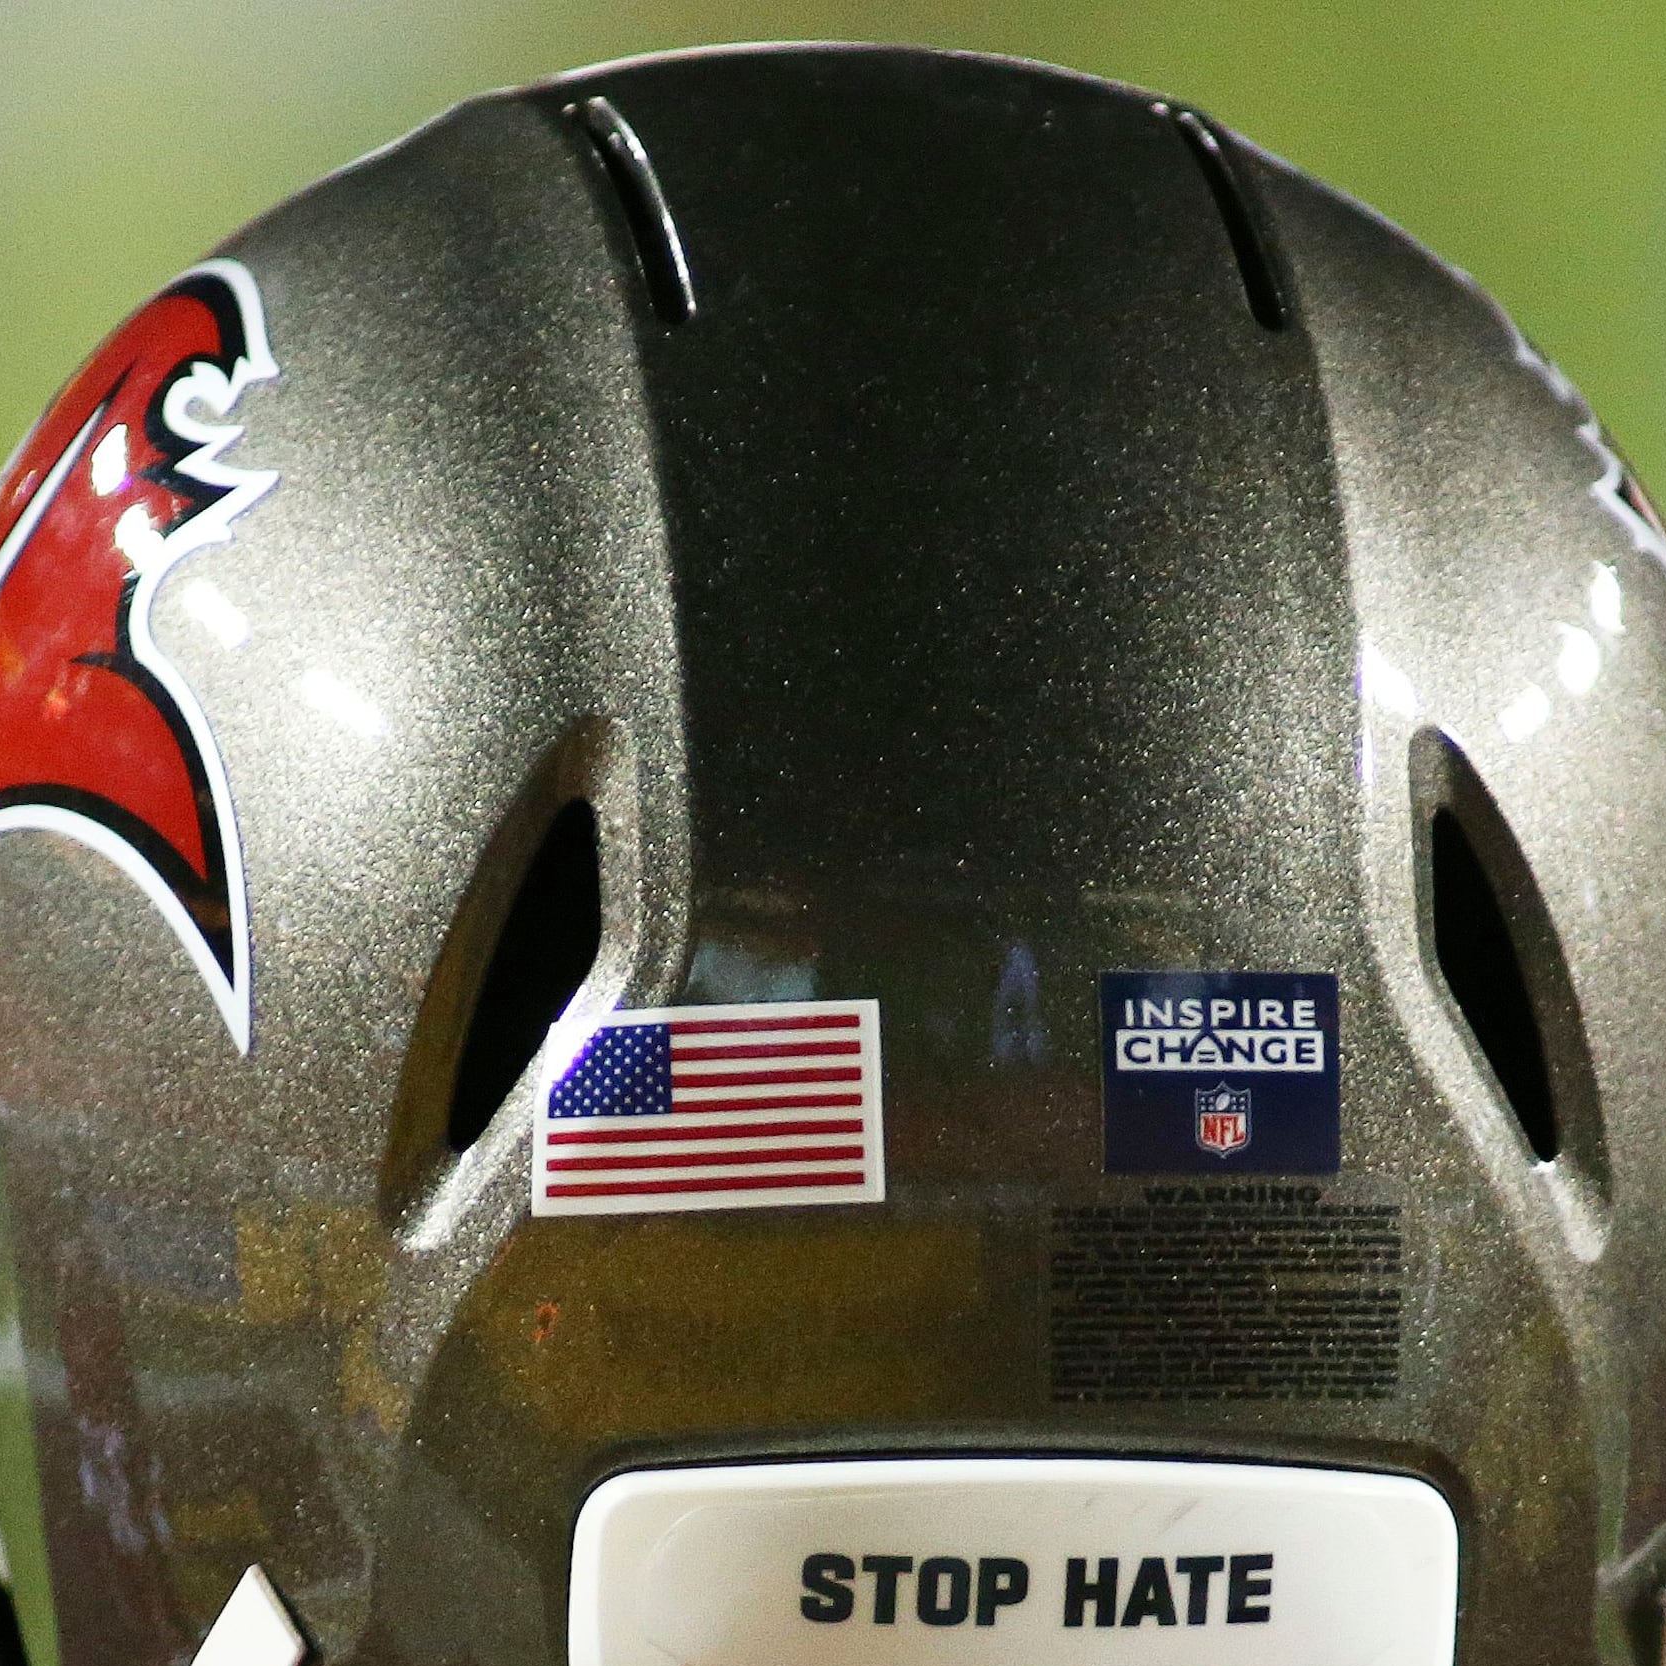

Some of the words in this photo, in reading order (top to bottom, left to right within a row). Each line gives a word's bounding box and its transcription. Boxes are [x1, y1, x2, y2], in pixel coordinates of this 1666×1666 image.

[1124, 999, 1317, 1028] INSPIRE
[1123, 1031, 1317, 1064] CHANGE
[1202, 1115, 1245, 1147] NFL
[1143, 1186, 1321, 1204] WARNING
[800, 1553, 1029, 1627] STOP
[1063, 1553, 1274, 1627] HATE
